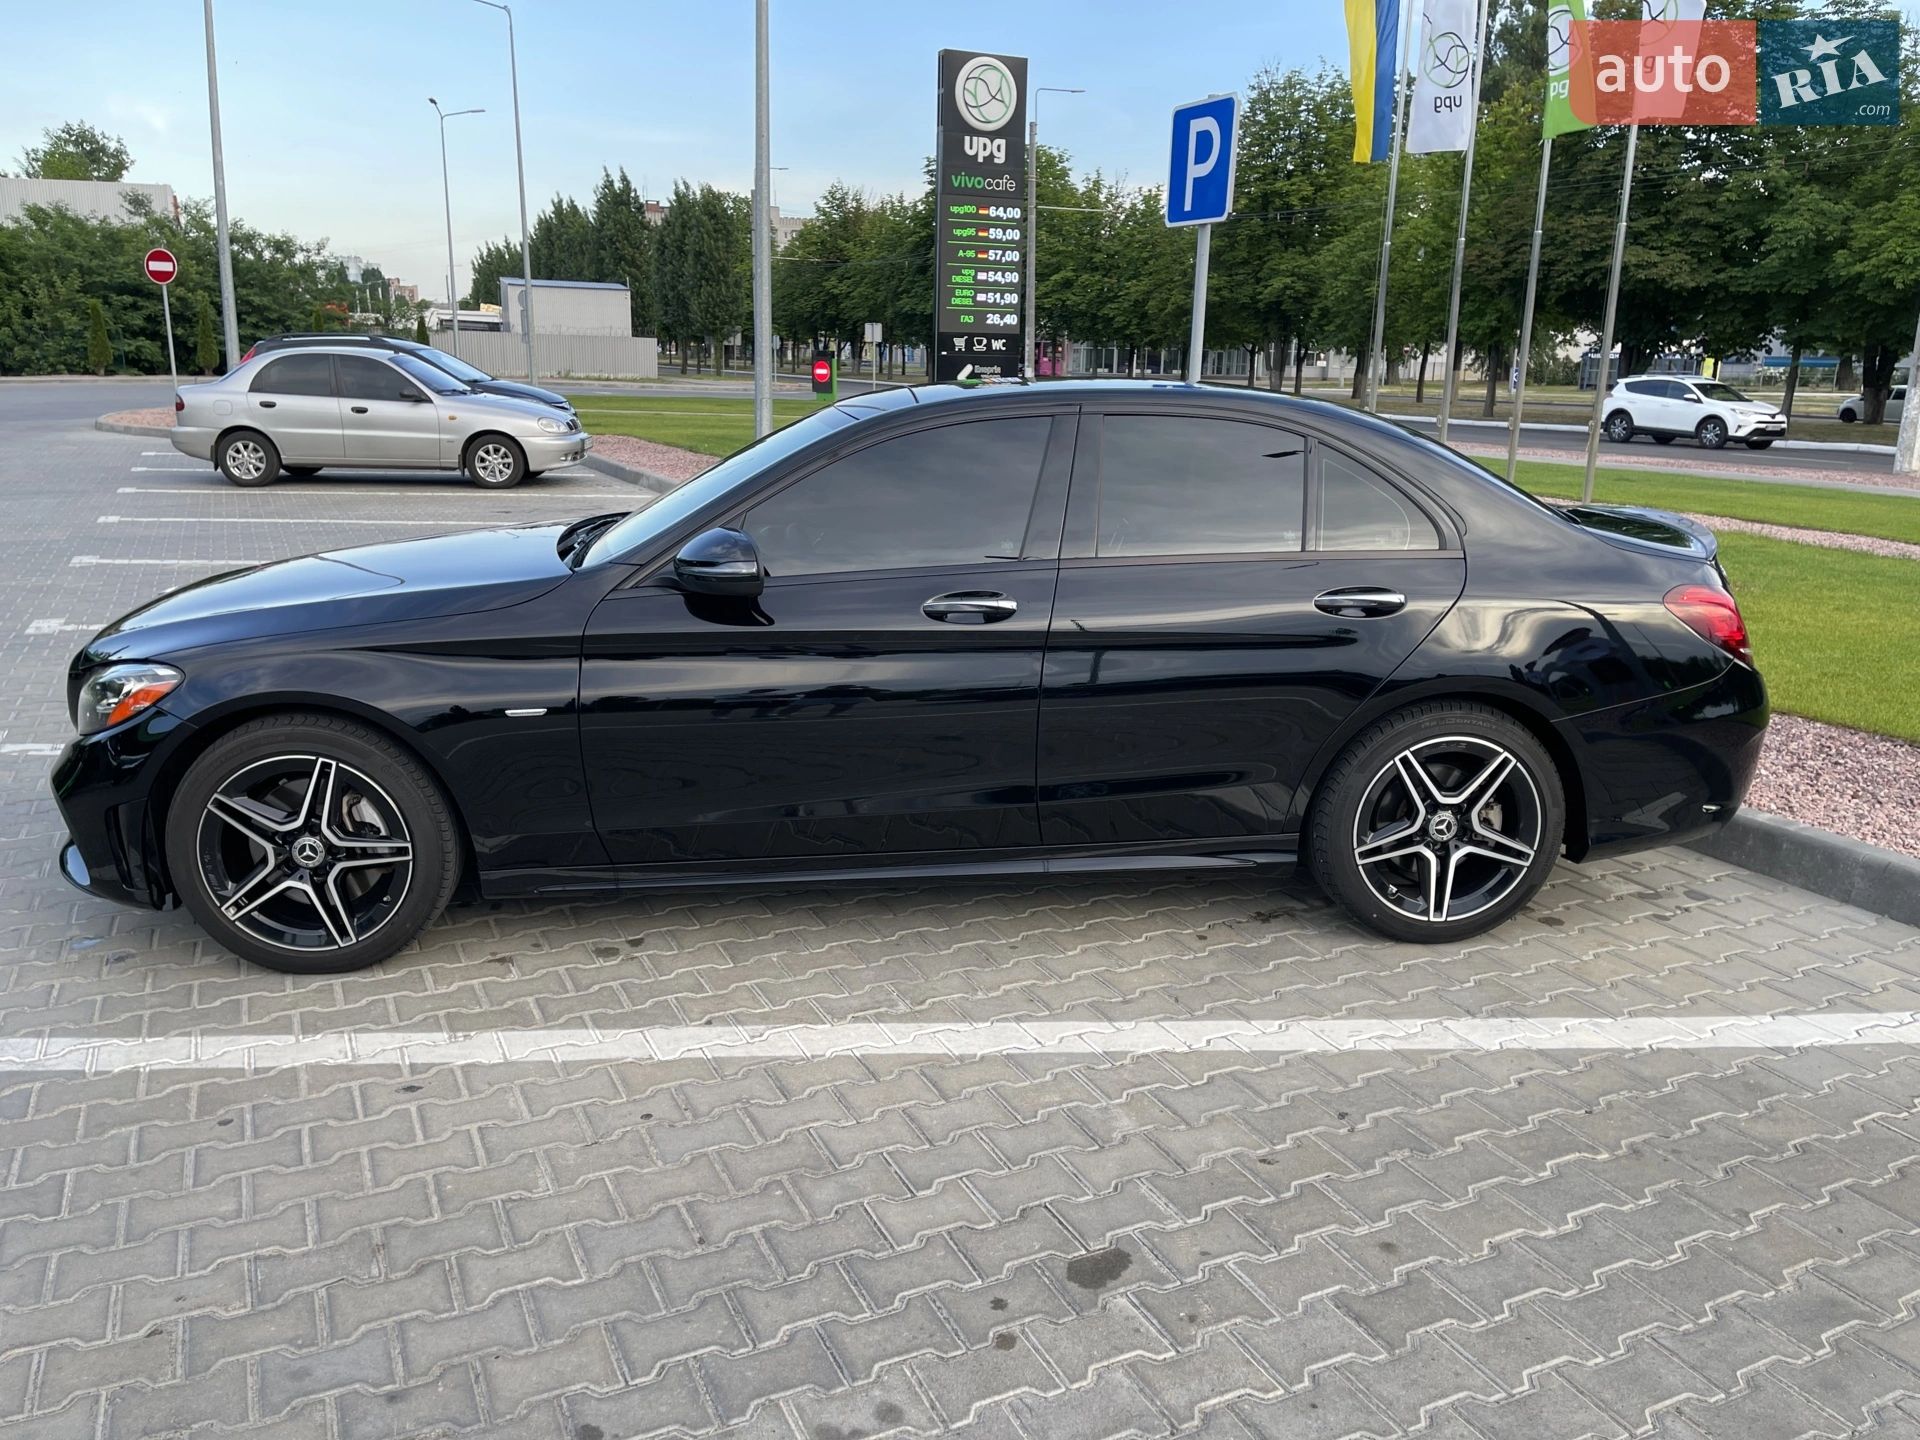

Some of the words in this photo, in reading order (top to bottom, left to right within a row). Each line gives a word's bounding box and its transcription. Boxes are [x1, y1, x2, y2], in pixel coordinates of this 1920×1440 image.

[1550, 79, 1570, 101] pg
[964, 135, 1006, 164] upg
[1184, 116, 1221, 212] P
[950, 205, 977, 214] upg100
[989, 205, 1021, 220] 64,00
[953, 227, 976, 237] upg95
[988, 227, 1020, 242] 59,00
[988, 250, 1020, 263] 57,00
[961, 268, 975, 276] upg
[987, 271, 1019, 285] 54,90
[951, 275, 975, 283] DIESEL
[955, 289, 975, 297] EURO
[986, 292, 1018, 306] 51,90
[951, 297, 974, 305] DIESEL
[960, 315, 974, 323] ГАЗ
[986, 313, 1018, 326] 26,40
[991, 338, 1007, 351] WC
